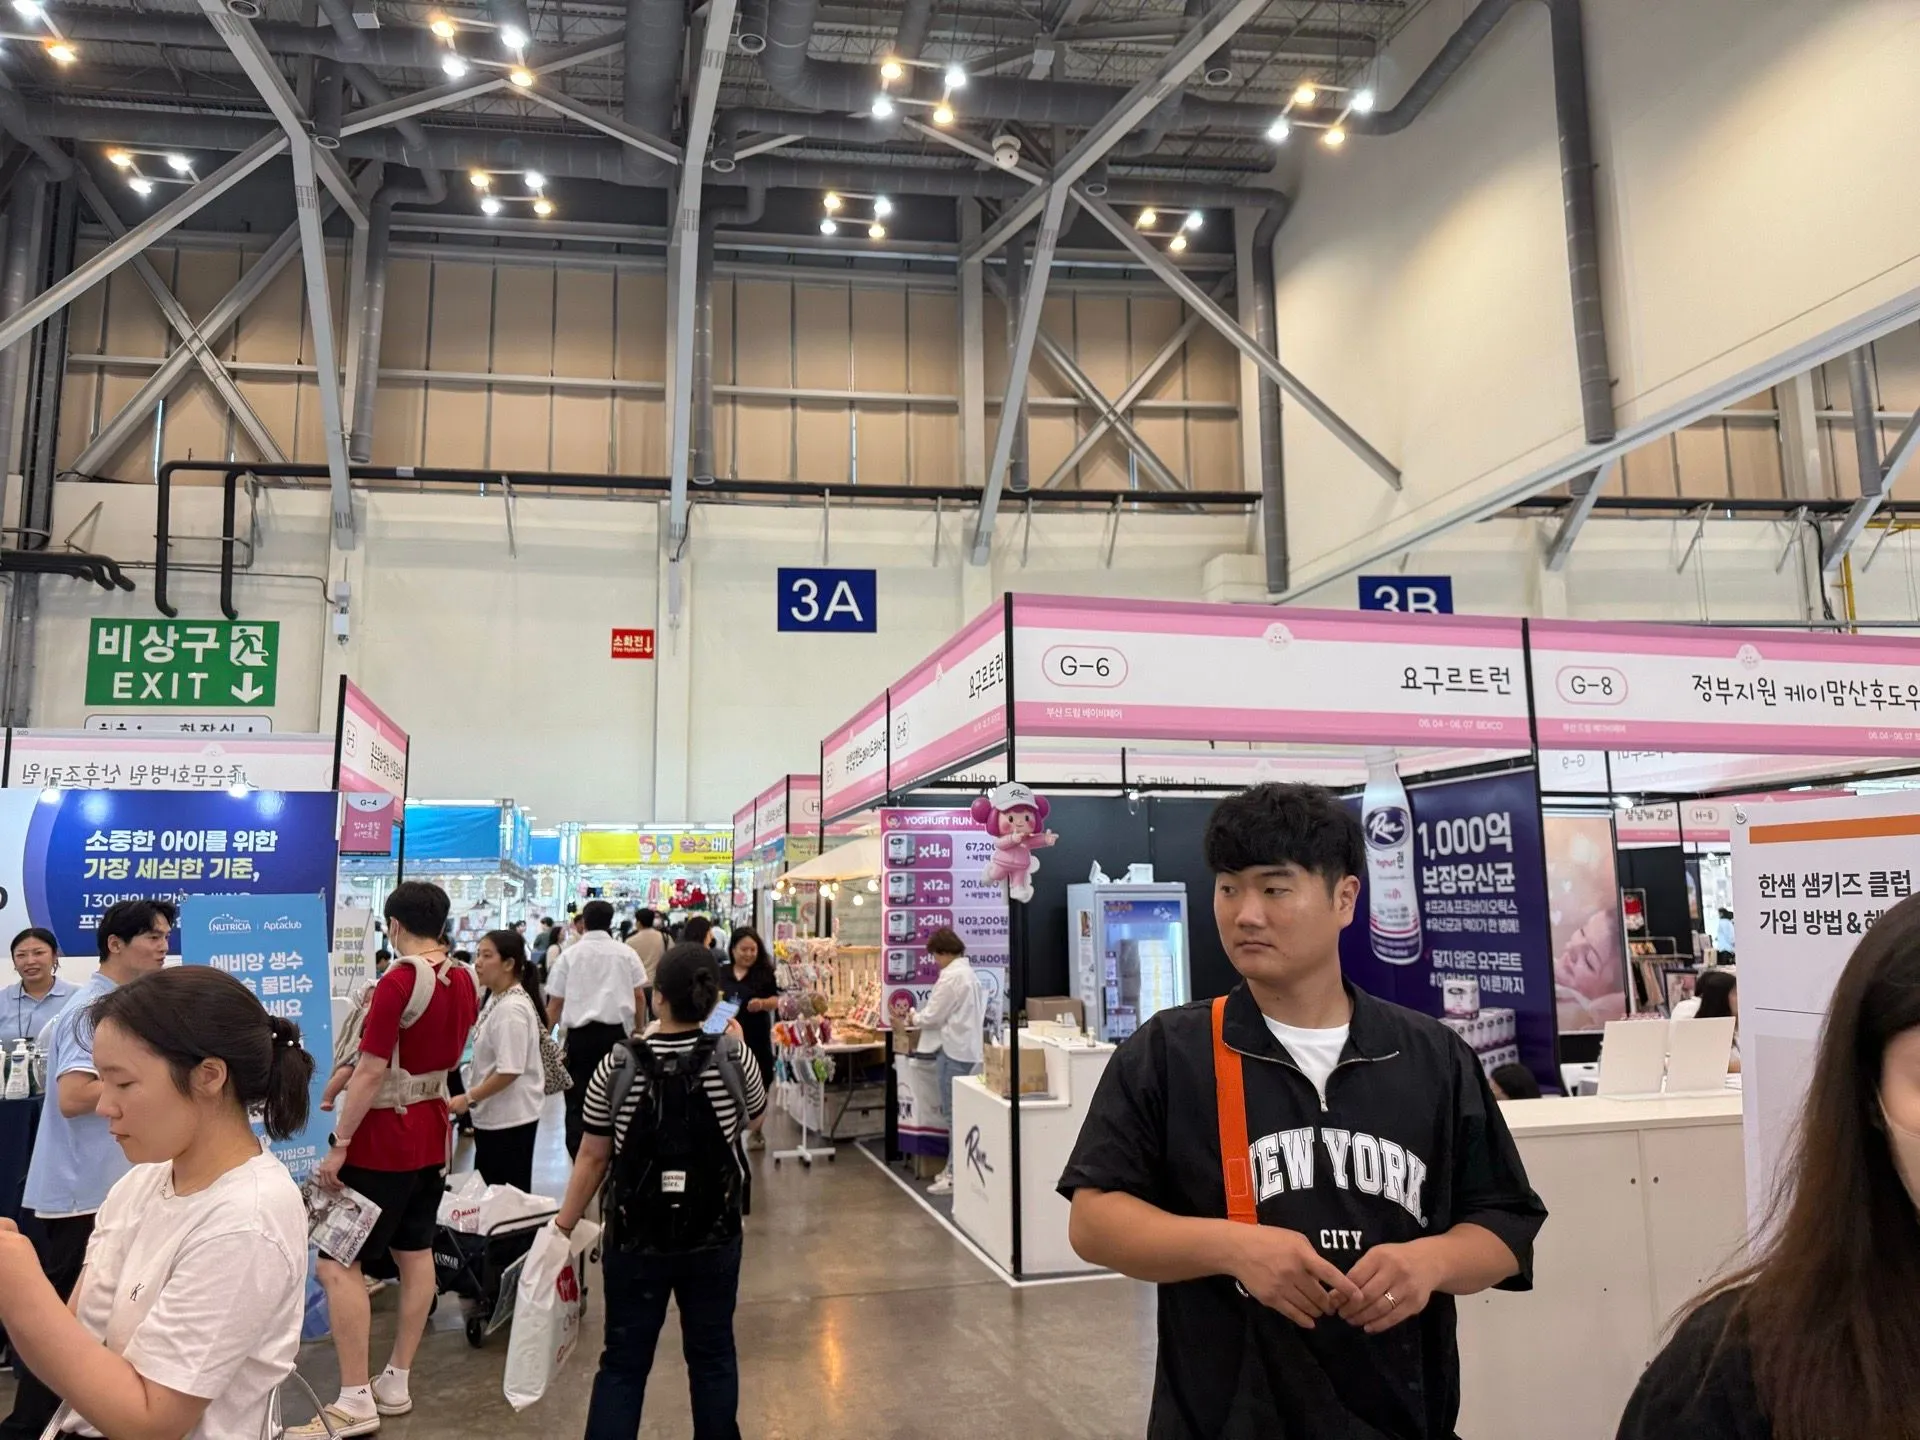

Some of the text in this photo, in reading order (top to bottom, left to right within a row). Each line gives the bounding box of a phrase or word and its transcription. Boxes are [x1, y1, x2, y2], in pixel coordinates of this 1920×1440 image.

[790, 577, 864, 623] 3A
[1374, 585, 1440, 614] 3B
[98, 624, 221, 664] 비상구
[613, 635, 644, 648] 소화전
[968, 651, 1004, 700] 요구르트런
[1059, 655, 1111, 677] G-6
[112, 671, 209, 700] EXIT
[1400, 666, 1512, 696] 요구르트런
[1571, 675, 1613, 697] G-8
[1692, 674, 1920, 711] 정부지원 케이맘산후도우
[904, 816, 951, 825] YOGHURT
[952, 816, 973, 825] RUN
[1656, 808, 1673, 821] ZIP
[84, 829, 278, 853] 소중한 아이를 위한
[1417, 811, 1513, 861] 1,000억
[83, 857, 261, 882] 가장 세심한 기준,
[1422, 862, 1516, 895] 보장유산균
[1758, 869, 1912, 899] 한샘 샘키즈 클럽
[212, 922, 251, 932] NUTRICIA
[263, 921, 302, 931] Aptaclub
[958, 916, 1009, 926] 403,200원
[1759, 908, 1797, 935] 가입
[1803, 909, 1843, 936] 방법
[209, 950, 304, 973] 에비앙 생수
[1477, 951, 1523, 972] 요구르트
[1480, 974, 1525, 995] 어른까지
[263, 998, 303, 1018] 세요
[1320, 1127, 1427, 1224] YORK
[1319, 1229, 1363, 1250] CITY
